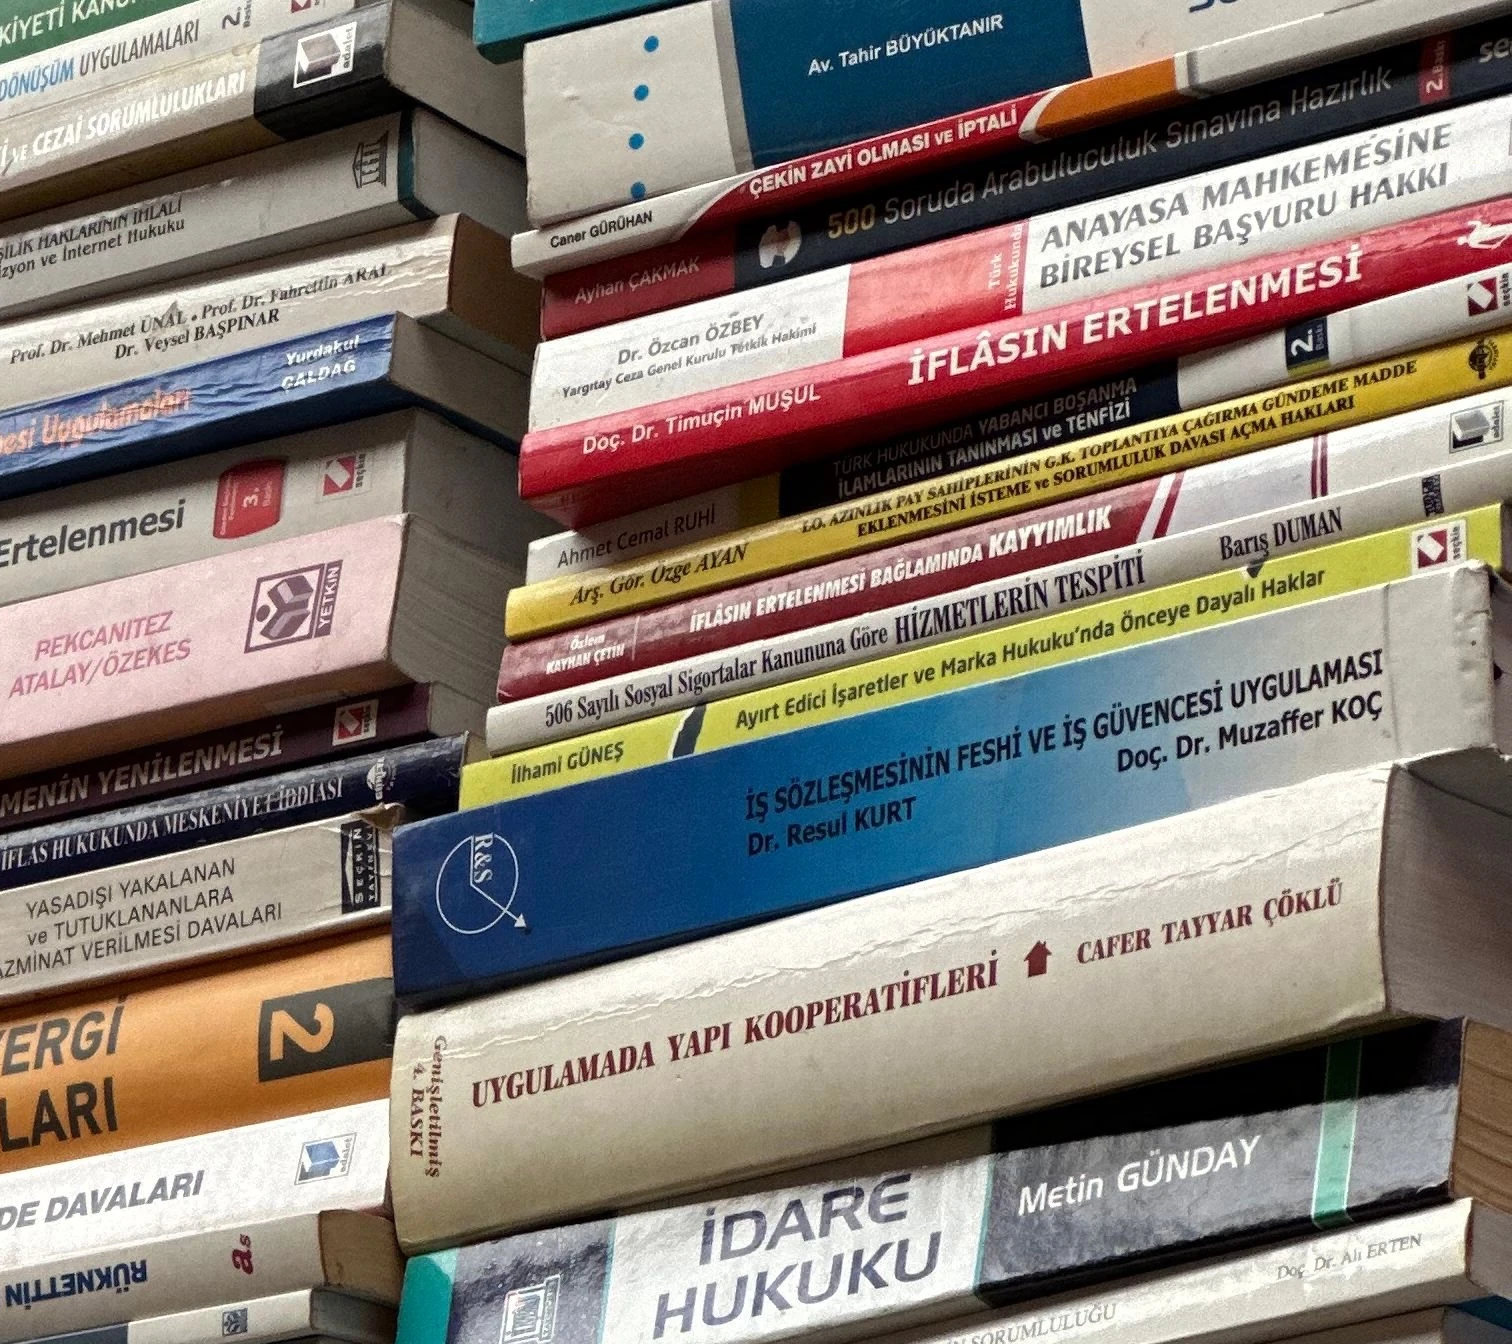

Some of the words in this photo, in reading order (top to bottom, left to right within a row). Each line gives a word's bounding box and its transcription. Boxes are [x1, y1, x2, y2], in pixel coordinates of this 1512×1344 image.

[808, 58, 832, 78] Av.
[839, 45, 881, 68] Tahir
[886, 14, 1003, 57] BÜYÜKTANIR
[749, 166, 807, 198] ÇEKİN
[811, 150, 854, 182] ZAYİ
[858, 134, 930, 167] OLMASI
[958, 105, 1018, 141] İPTALİ
[1041, 192, 1189, 252] ANAYASA
[1202, 122, 1453, 209] MAHKEMESİNE
[1040, 232, 1180, 289] BİREYSEL
[1194, 198, 1338, 249] BAŞVURU
[1350, 163, 1448, 208] HAKKI
[908, 321, 1067, 386] İFLÂSIN
[1082, 244, 1363, 343] ERTELENMESİ
[319, 564, 341, 633] YETKİN
[745, 790, 769, 823] İŞ
[773, 745, 951, 812] SÖZLEŞMESİNİN
[958, 730, 1023, 771] FESHİ
[1029, 726, 1056, 752] VE
[1063, 718, 1087, 747] İŞ
[1092, 683, 1224, 741] GÜVENCESİ
[1231, 649, 1383, 708] UYGULAMASI
[472, 1045, 655, 1110] UYGULAMADA
[667, 1023, 732, 1062] YAPI
[743, 950, 999, 1046] KOOPERATİFLERİ
[44, 1170, 204, 1224] DAVALARI
[698, 1174, 912, 1265] İDARE
[1018, 1176, 1104, 1217] Metin
[1118, 1136, 1261, 1192] GÜNDAY
[653, 1232, 942, 1339] HUKUKU
